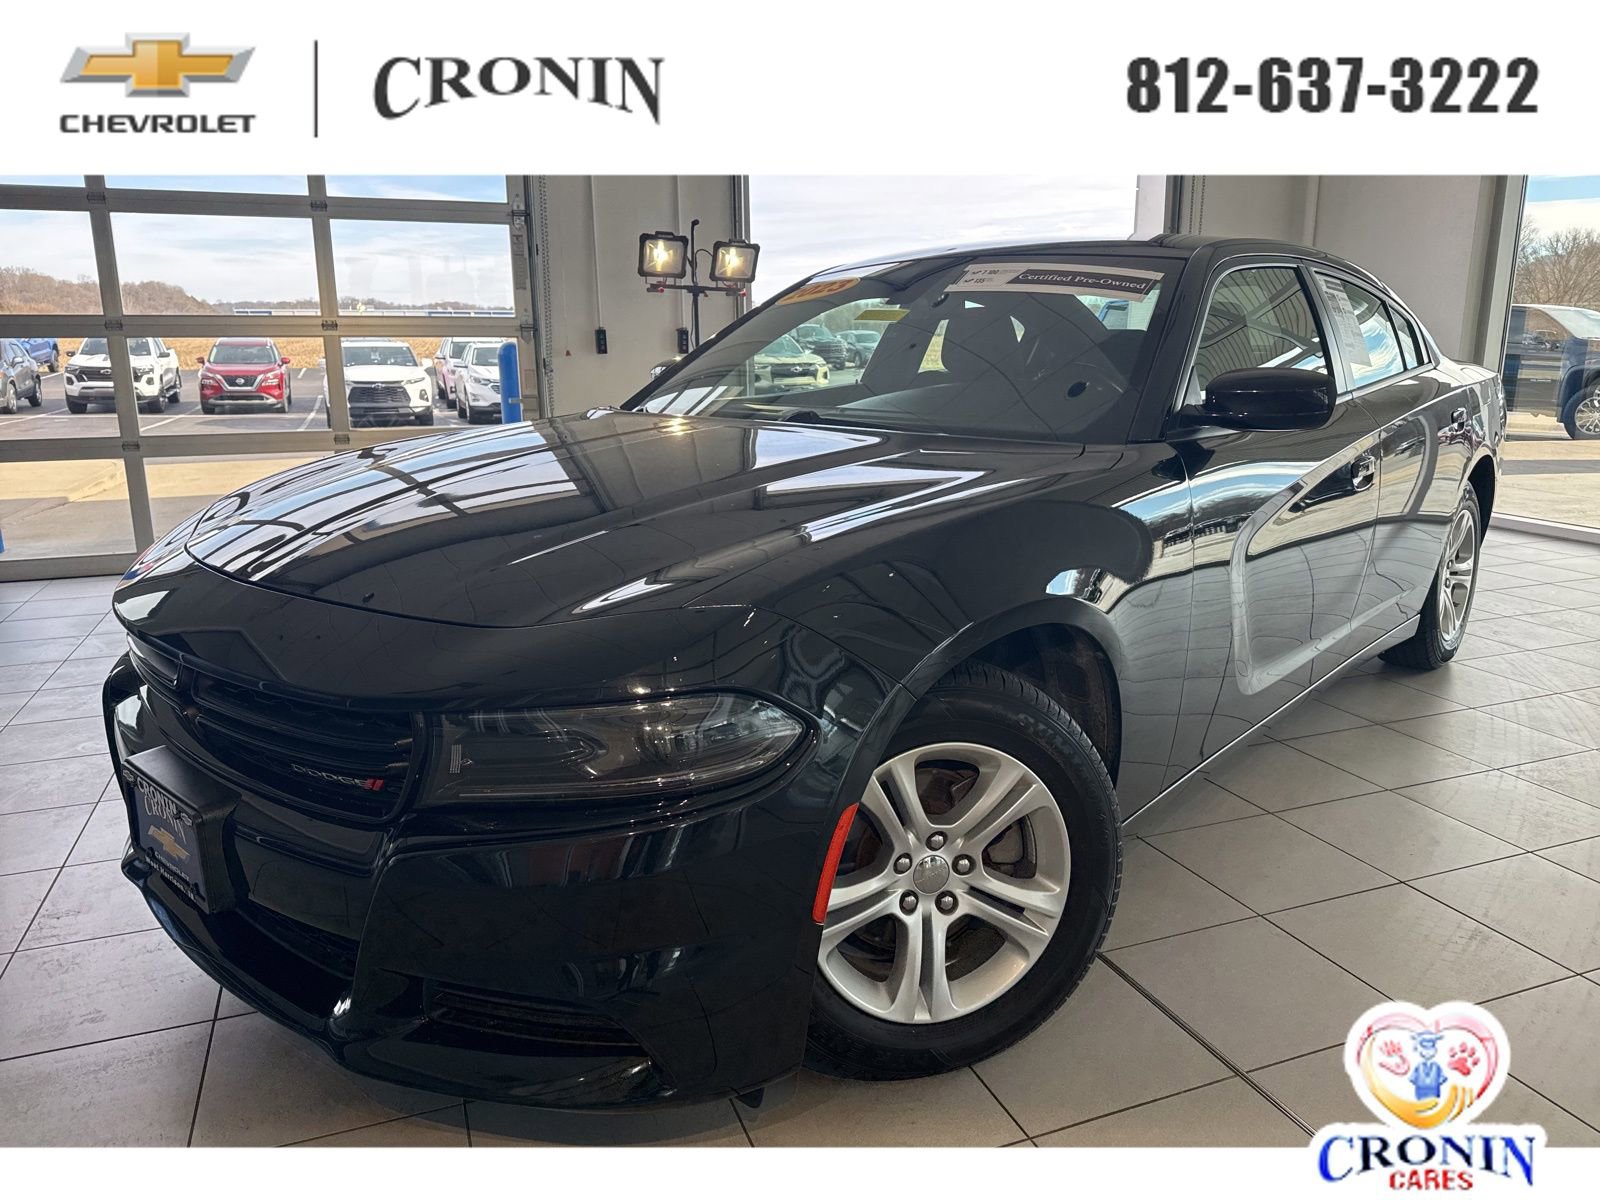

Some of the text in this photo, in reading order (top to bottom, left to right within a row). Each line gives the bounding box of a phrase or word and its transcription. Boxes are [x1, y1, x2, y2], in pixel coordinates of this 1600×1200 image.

[1019, 272, 1072, 284] Certified
[1074, 276, 1147, 289] Pre-Owned
[291, 763, 369, 787] DODGE
[137, 777, 177, 815] CRONIN
